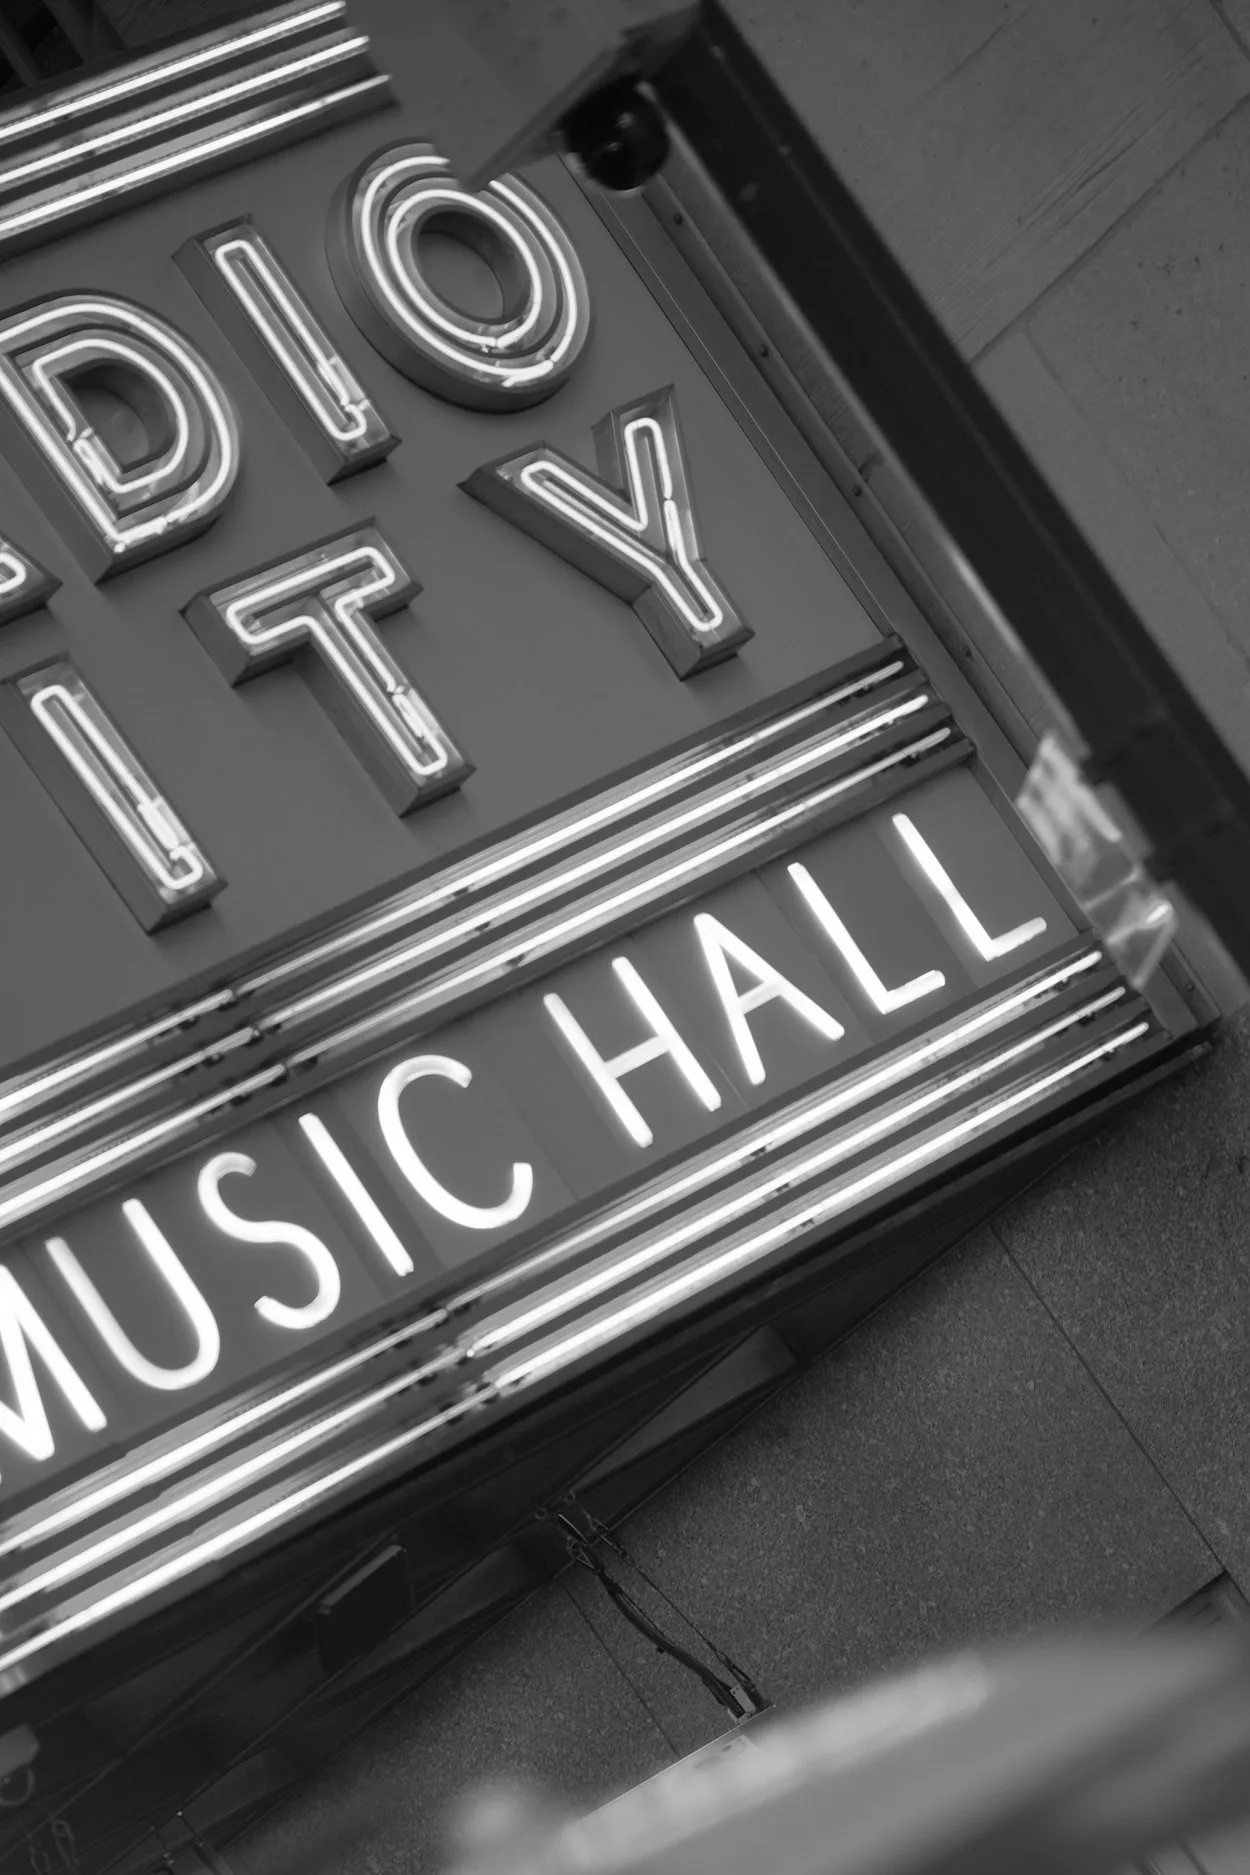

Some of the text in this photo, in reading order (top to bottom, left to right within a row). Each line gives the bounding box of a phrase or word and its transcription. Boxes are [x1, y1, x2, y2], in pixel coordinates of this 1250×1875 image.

[0, 138, 590, 622] DIO
[0, 814, 1046, 1461] MUSIC HALL
